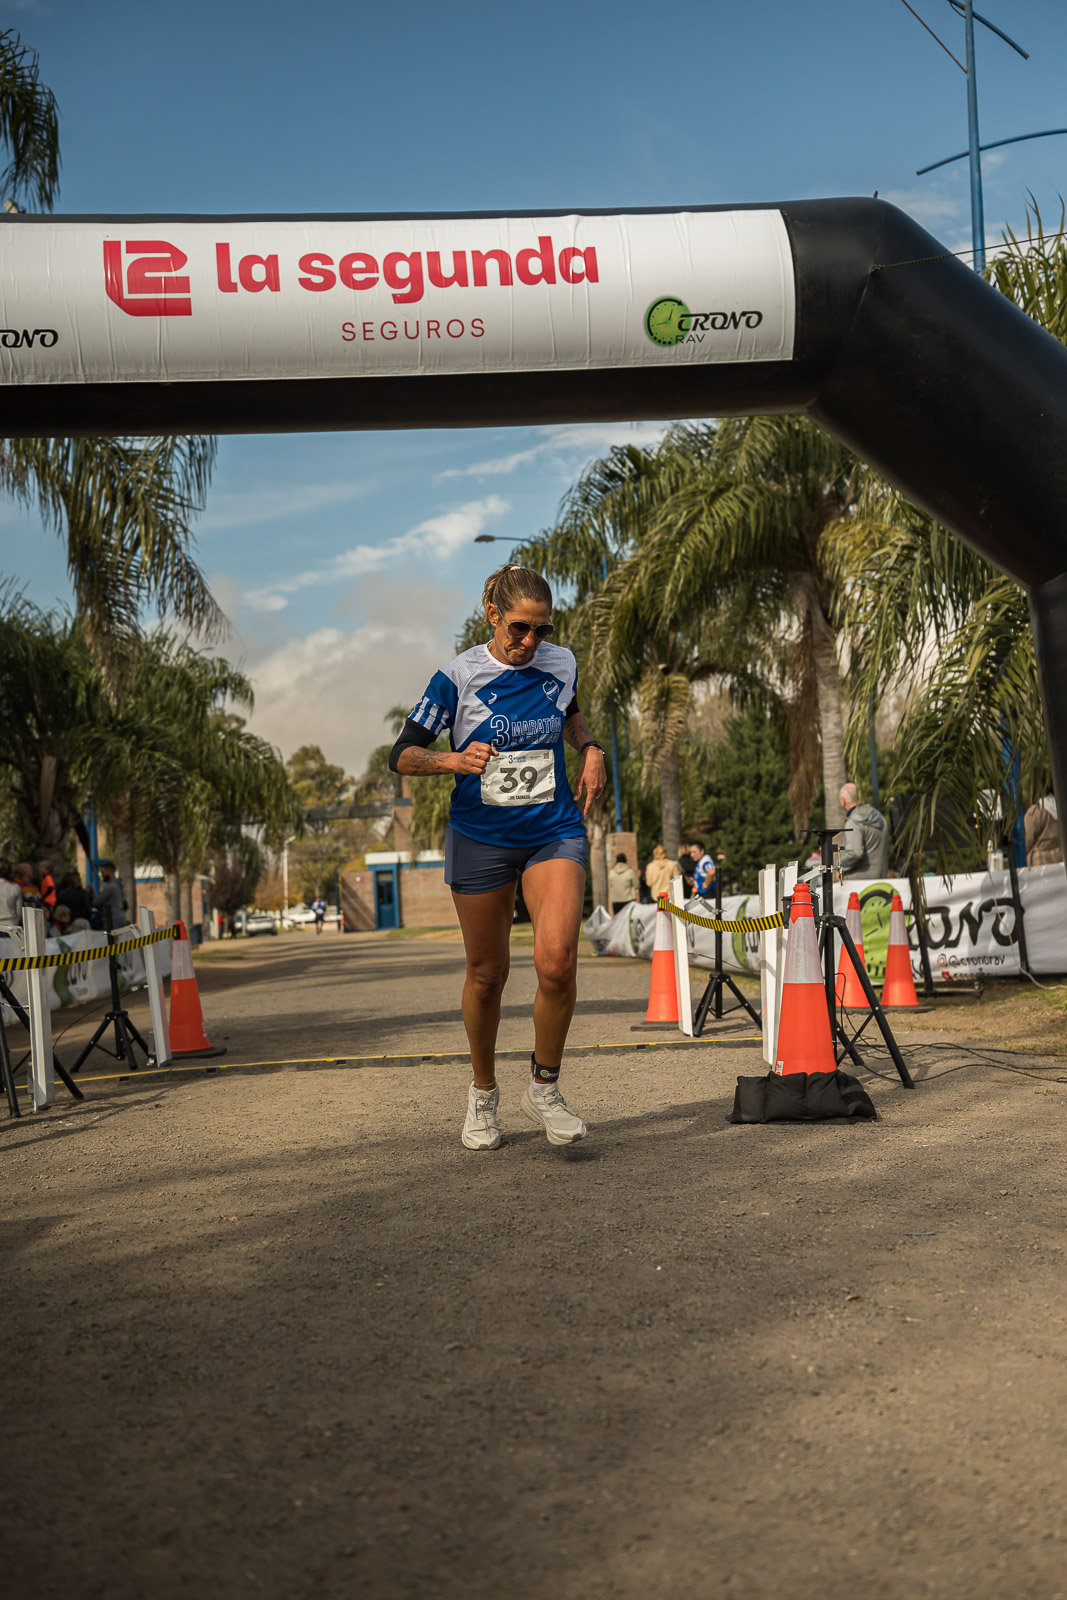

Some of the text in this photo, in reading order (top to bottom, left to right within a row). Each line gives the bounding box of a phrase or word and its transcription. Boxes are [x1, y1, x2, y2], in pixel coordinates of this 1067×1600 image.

[215, 235, 599, 304] la segunda
[341, 318, 485, 341] SEGUROS
[678, 310, 763, 331] CRONO
[0, 329, 58, 348] ONO
[676, 334, 705, 344] RAV
[490, 714, 510, 749] 3
[511, 715, 561, 737] MARATÓN
[499, 766, 538, 793] 39
